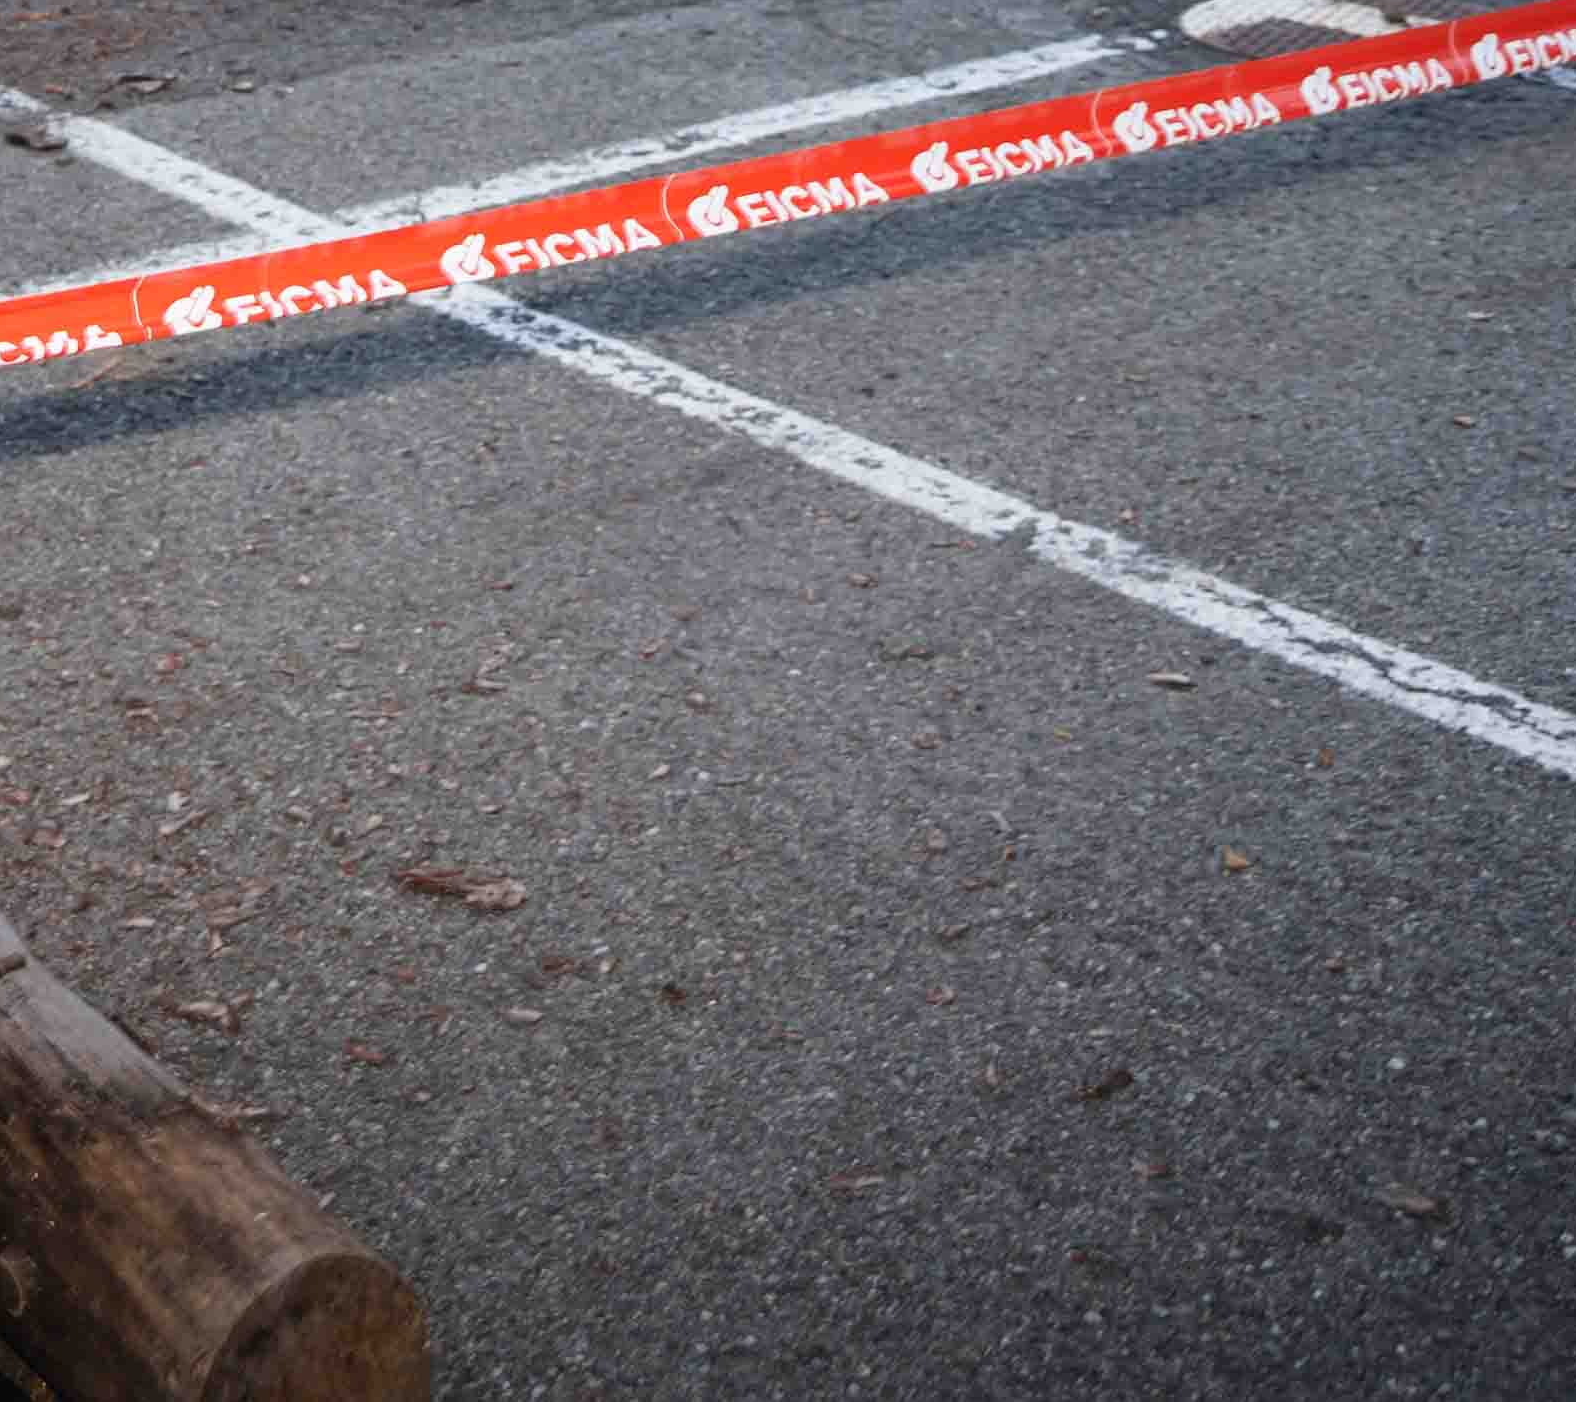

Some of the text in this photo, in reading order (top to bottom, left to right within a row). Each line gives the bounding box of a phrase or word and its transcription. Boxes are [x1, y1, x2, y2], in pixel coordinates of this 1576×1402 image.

[1345, 56, 1454, 109] EICMA
[1155, 91, 1283, 146] EICMA
[962, 128, 1097, 185] EICMA
[740, 171, 891, 228] EICMA
